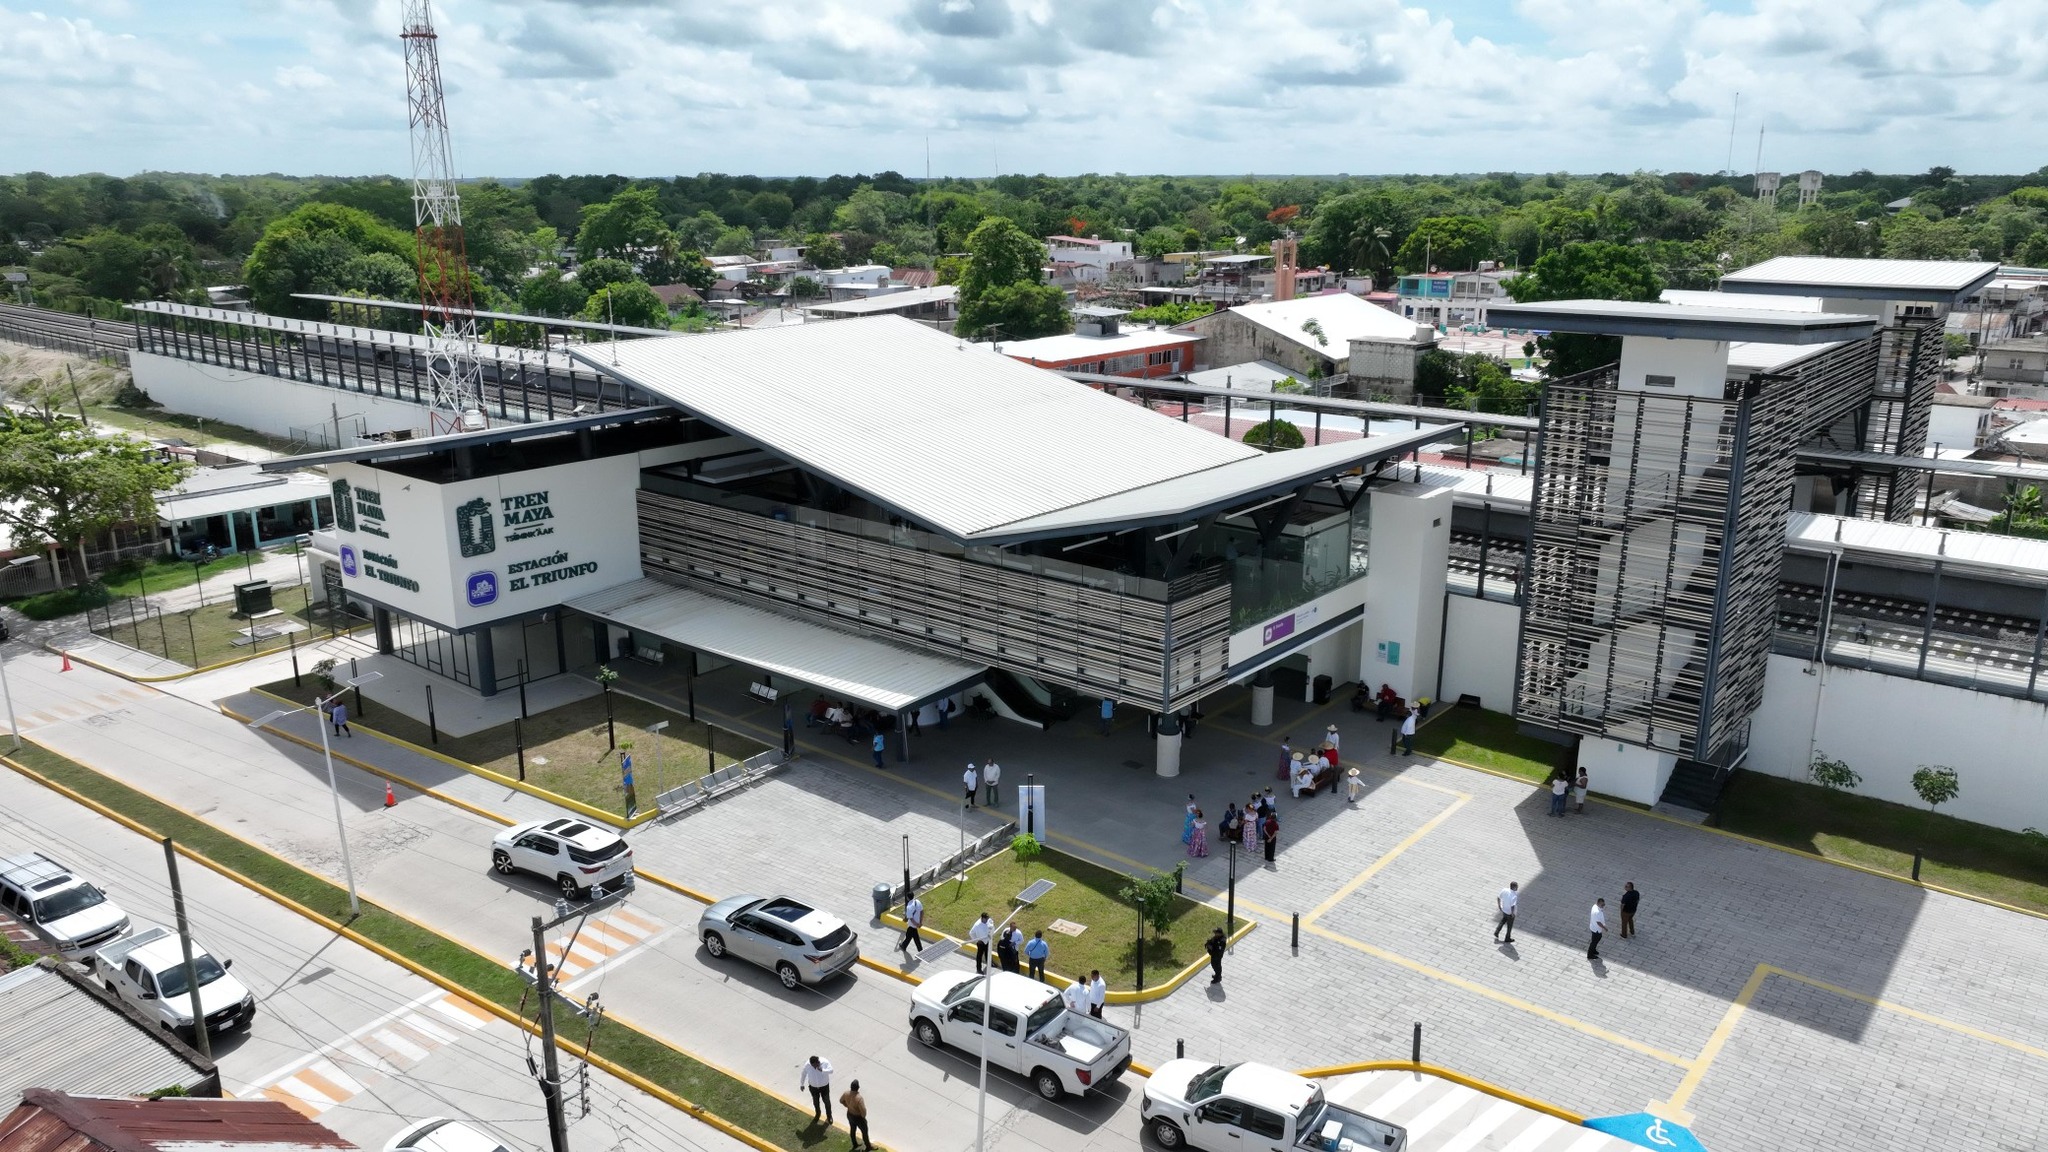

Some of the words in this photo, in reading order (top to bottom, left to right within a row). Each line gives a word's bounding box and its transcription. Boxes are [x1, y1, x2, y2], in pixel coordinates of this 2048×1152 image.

[354, 486, 381, 505] TREN
[501, 491, 549, 511] TREN
[356, 502, 386, 521] MAYA
[503, 506, 554, 527] MAYA
[507, 550, 568, 574] ESTACIÓN
[364, 564, 377, 578] EL
[377, 569, 420, 593] TRIUNFO
[509, 577, 530, 592] EL
[531, 562, 598, 586] TRIUNFO
